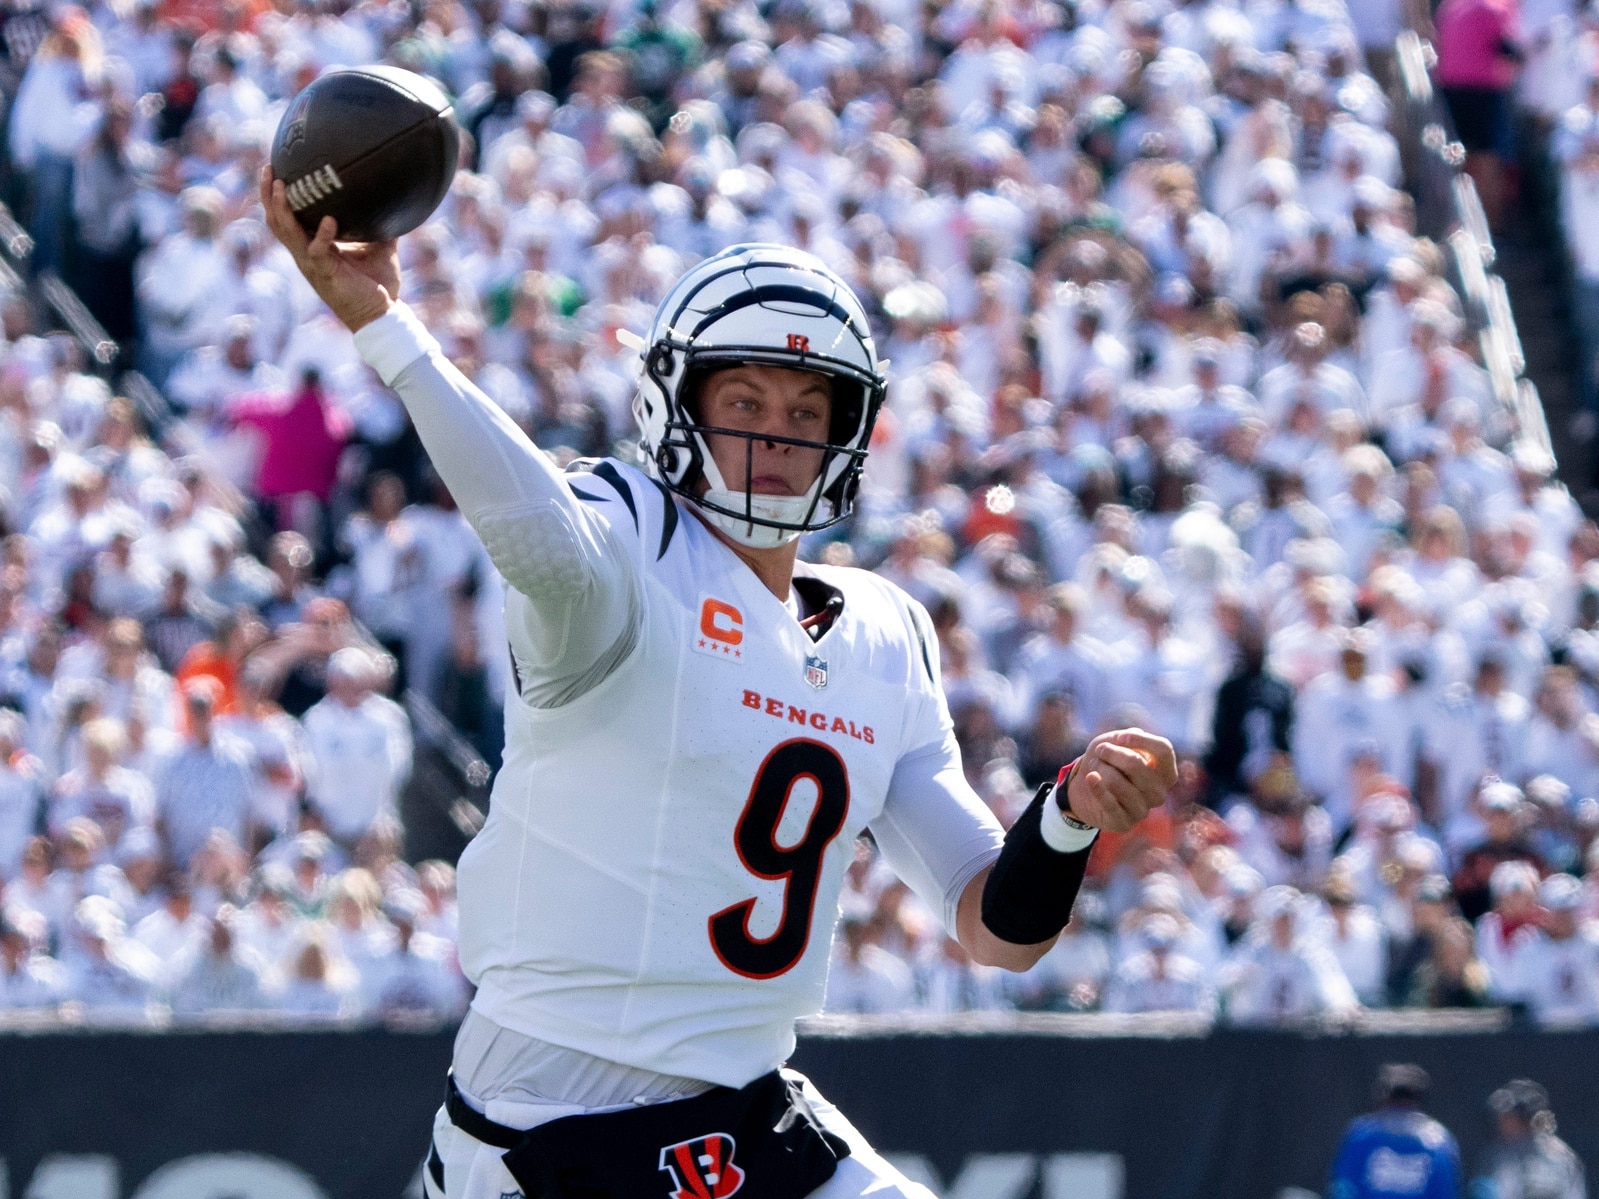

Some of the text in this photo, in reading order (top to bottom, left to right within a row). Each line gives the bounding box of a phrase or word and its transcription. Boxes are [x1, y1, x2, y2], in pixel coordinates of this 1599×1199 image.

[701, 597, 743, 646] C
[741, 689, 874, 744] BENGALS
[707, 736, 850, 980] 9
